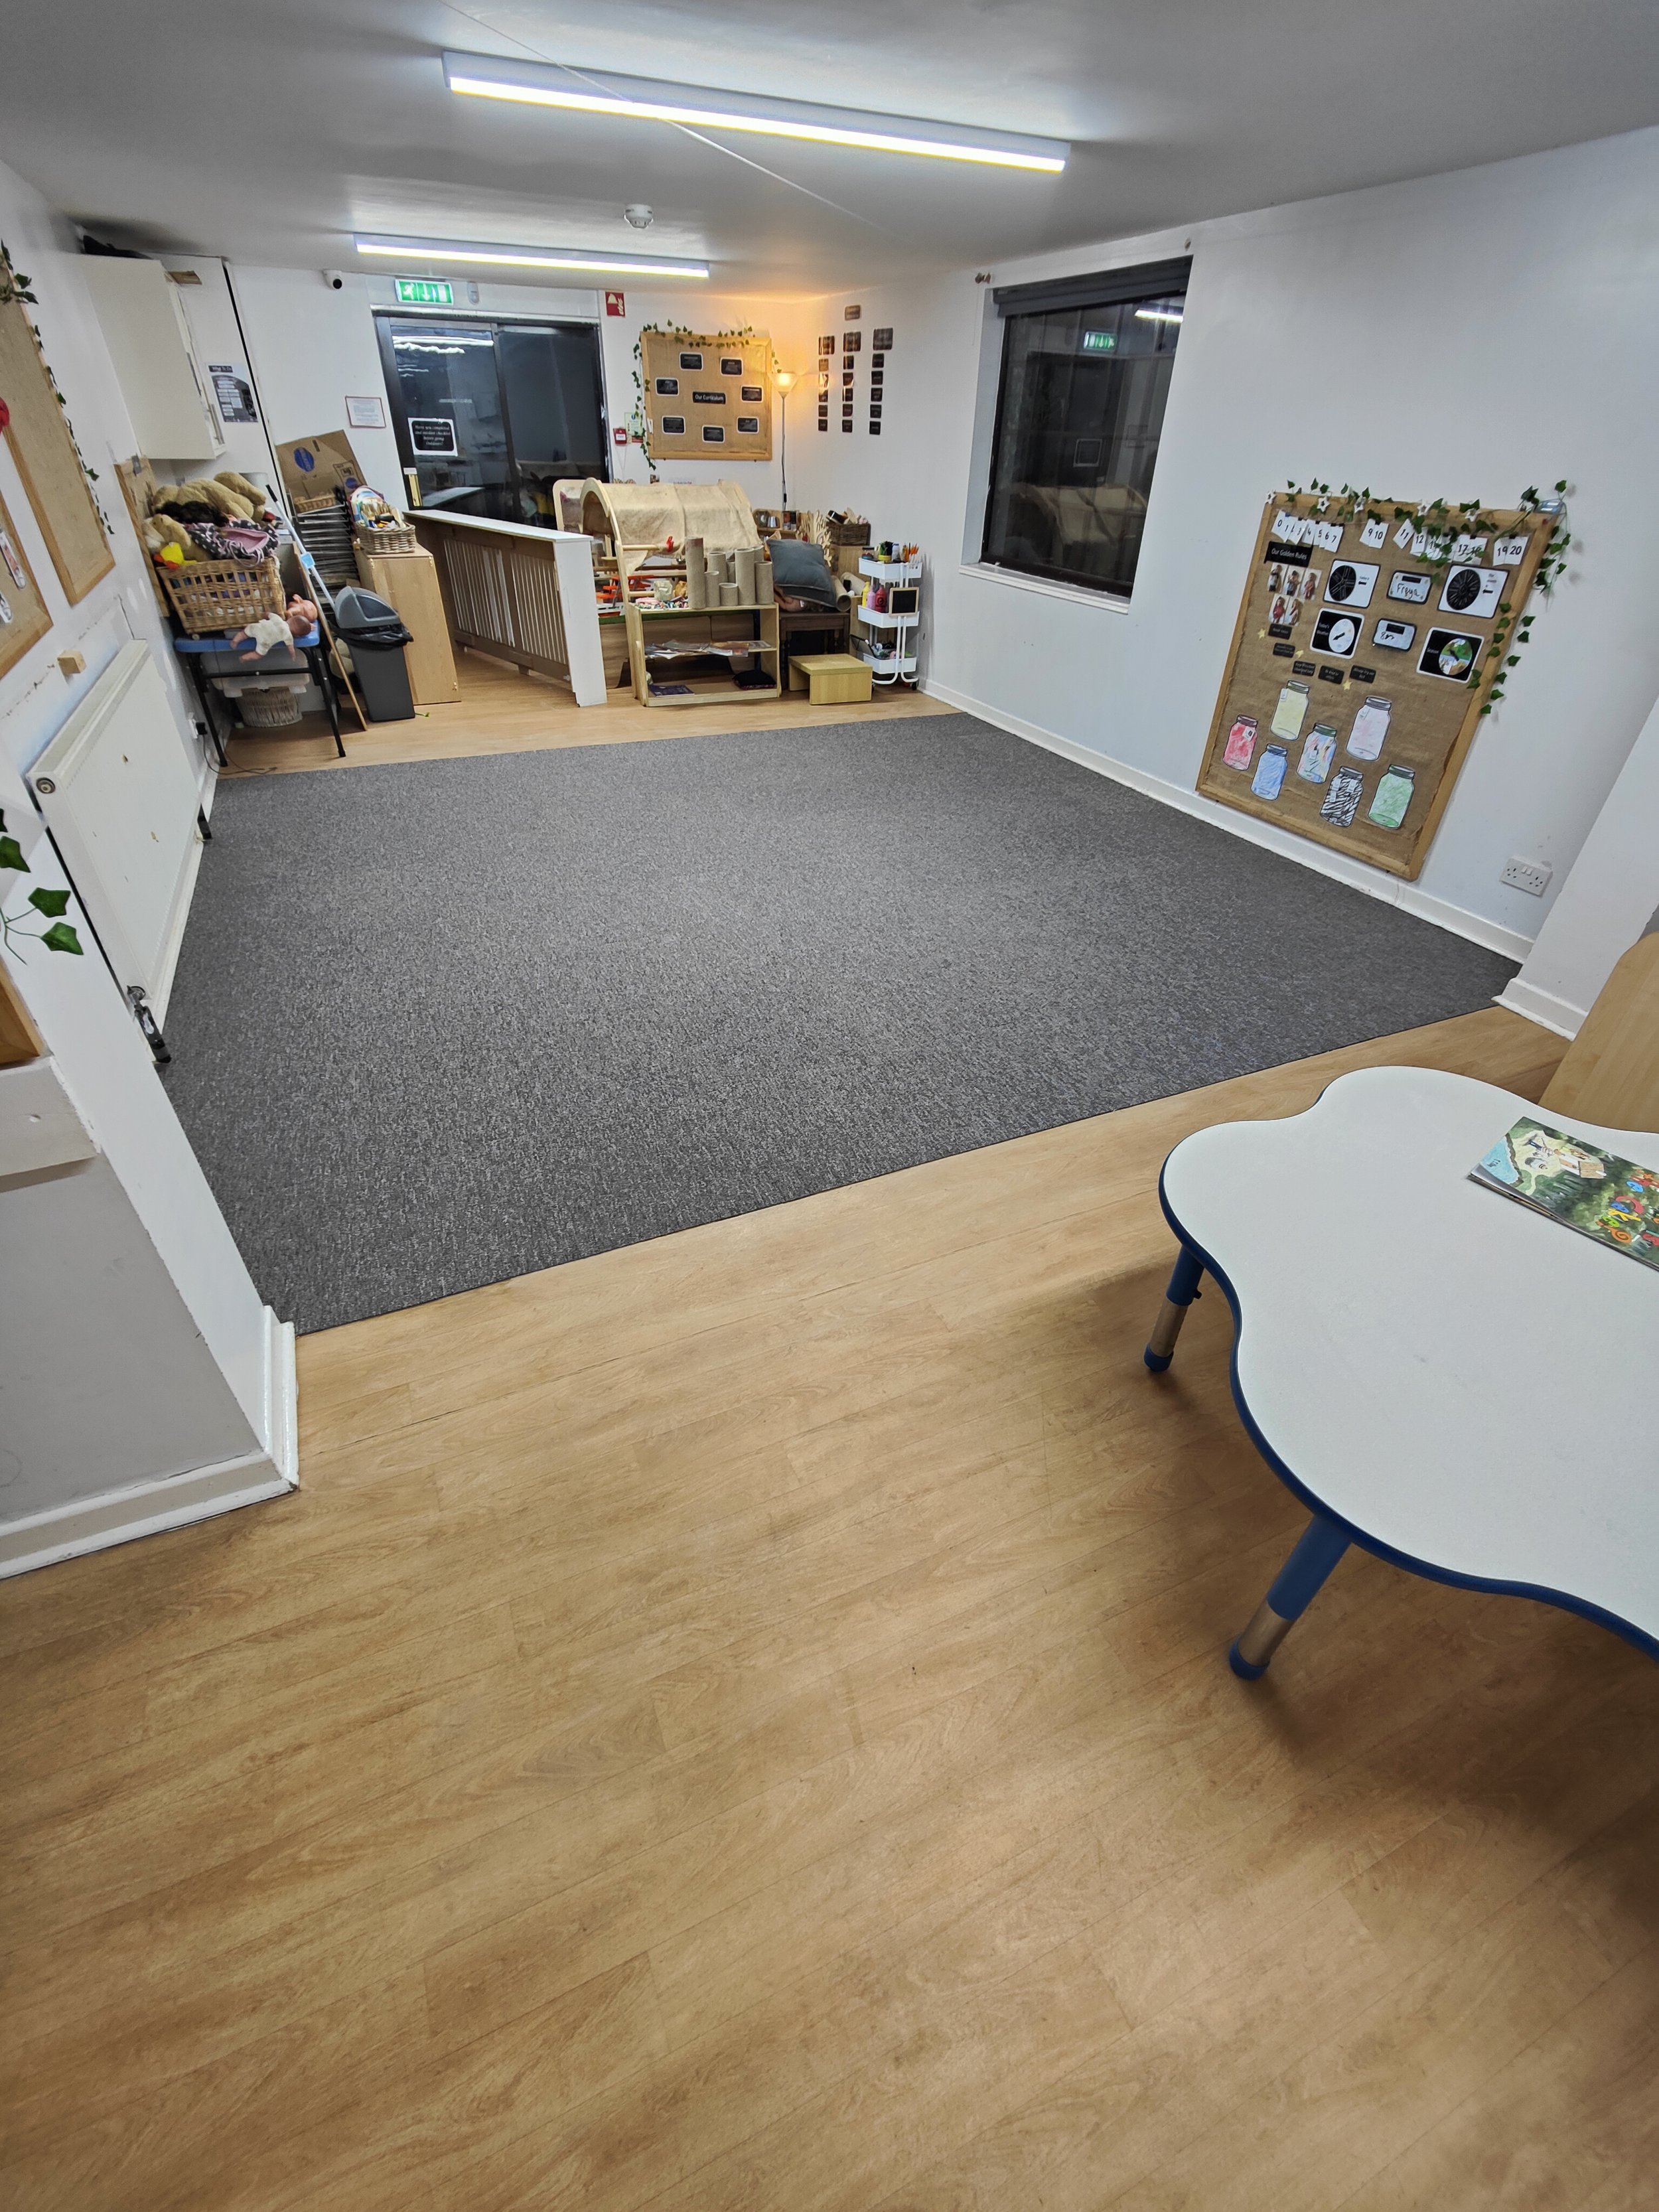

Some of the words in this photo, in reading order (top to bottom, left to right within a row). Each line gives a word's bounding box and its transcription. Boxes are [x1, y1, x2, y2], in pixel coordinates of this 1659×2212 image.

[1307, 527, 1311, 536] 4
[1318, 528, 1323, 538] 5
[1325, 532, 1330, 540] 6
[1331, 535, 1337, 544] 7
[1368, 528, 1373, 537] 9
[1374, 531, 1384, 540] 10
[1400, 528, 1409, 540] 11
[1415, 535, 1423, 544] 12
[1458, 544, 1469, 555] 17
[1498, 546, 1508, 557] 19
[1509, 546, 1522, 555] 20
[1279, 549, 1295, 557] Golden
